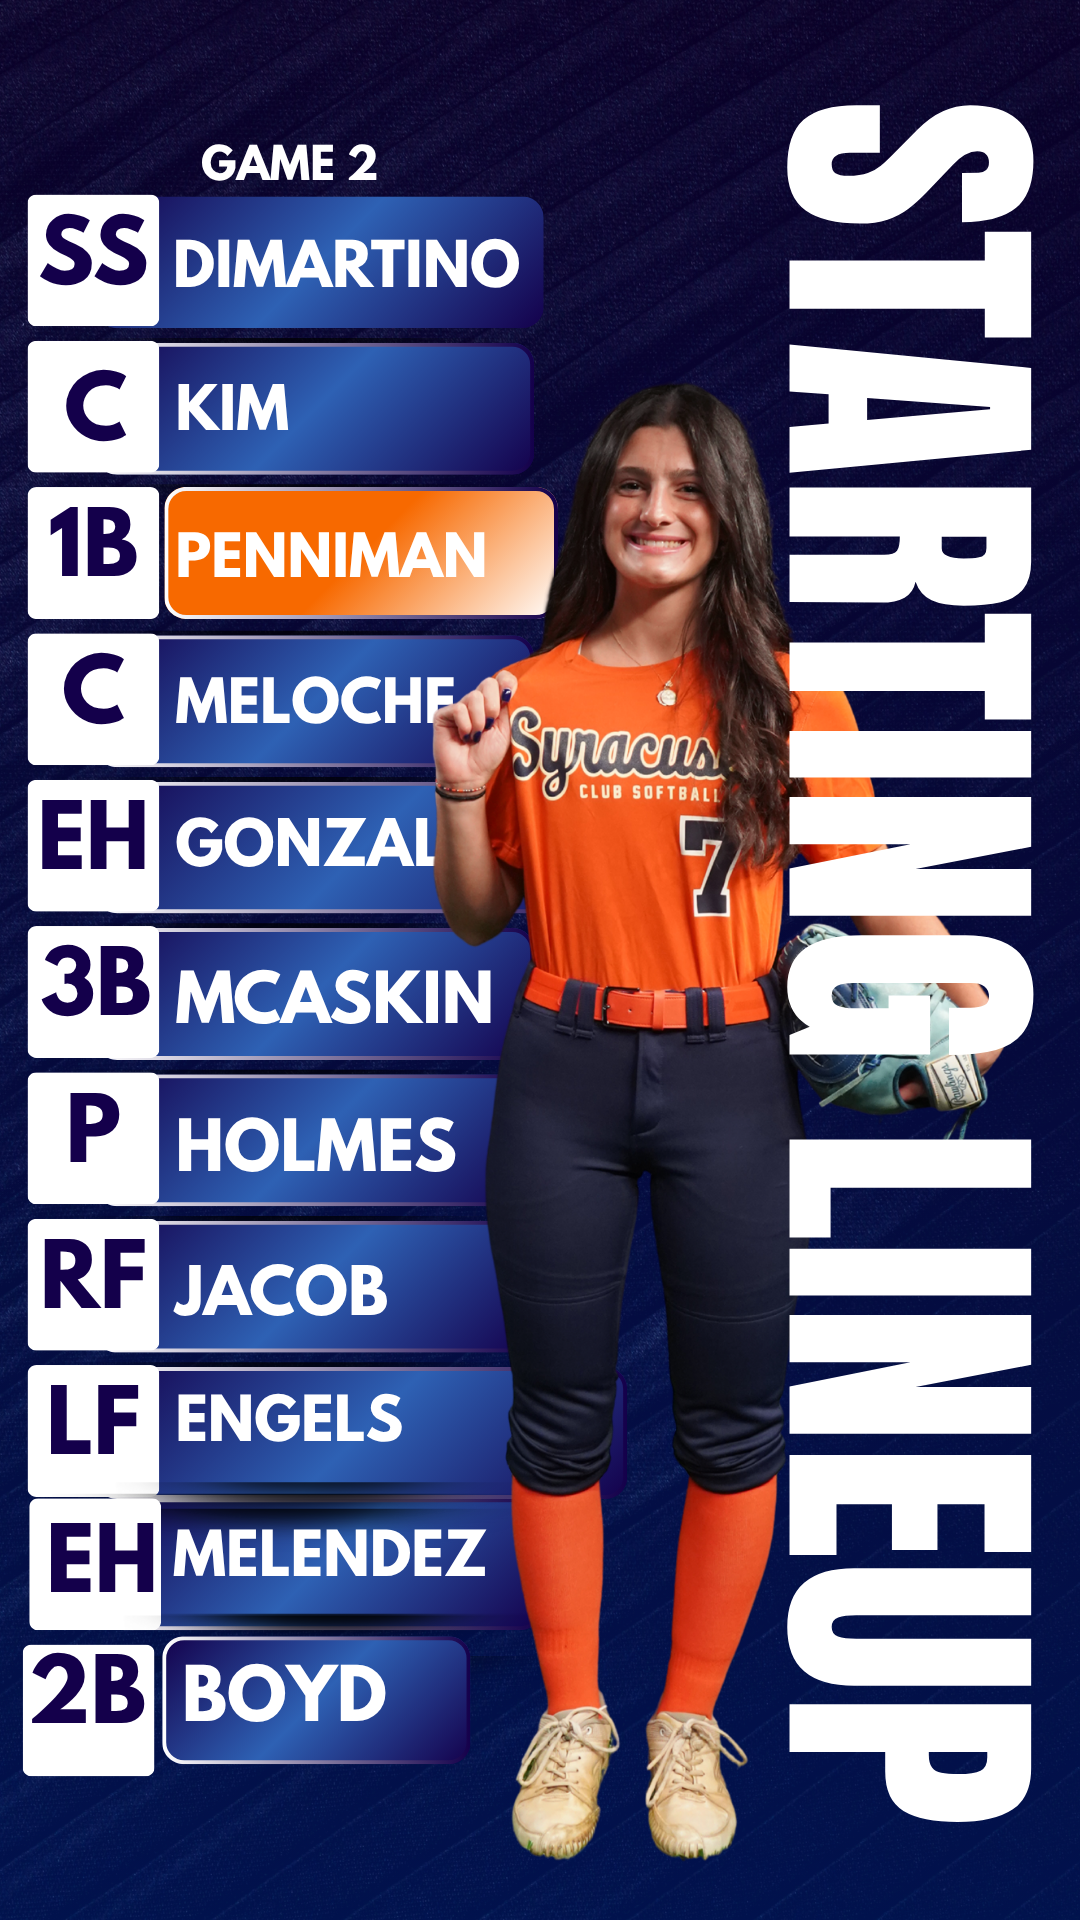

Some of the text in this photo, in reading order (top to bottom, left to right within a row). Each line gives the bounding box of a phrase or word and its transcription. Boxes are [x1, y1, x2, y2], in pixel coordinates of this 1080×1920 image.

[510, 706, 733, 801] Syracus
[579, 784, 721, 802] CLUB SOFTBALL
[679, 815, 742, 917] 7
[941, 1062, 966, 1106] Rawlings
